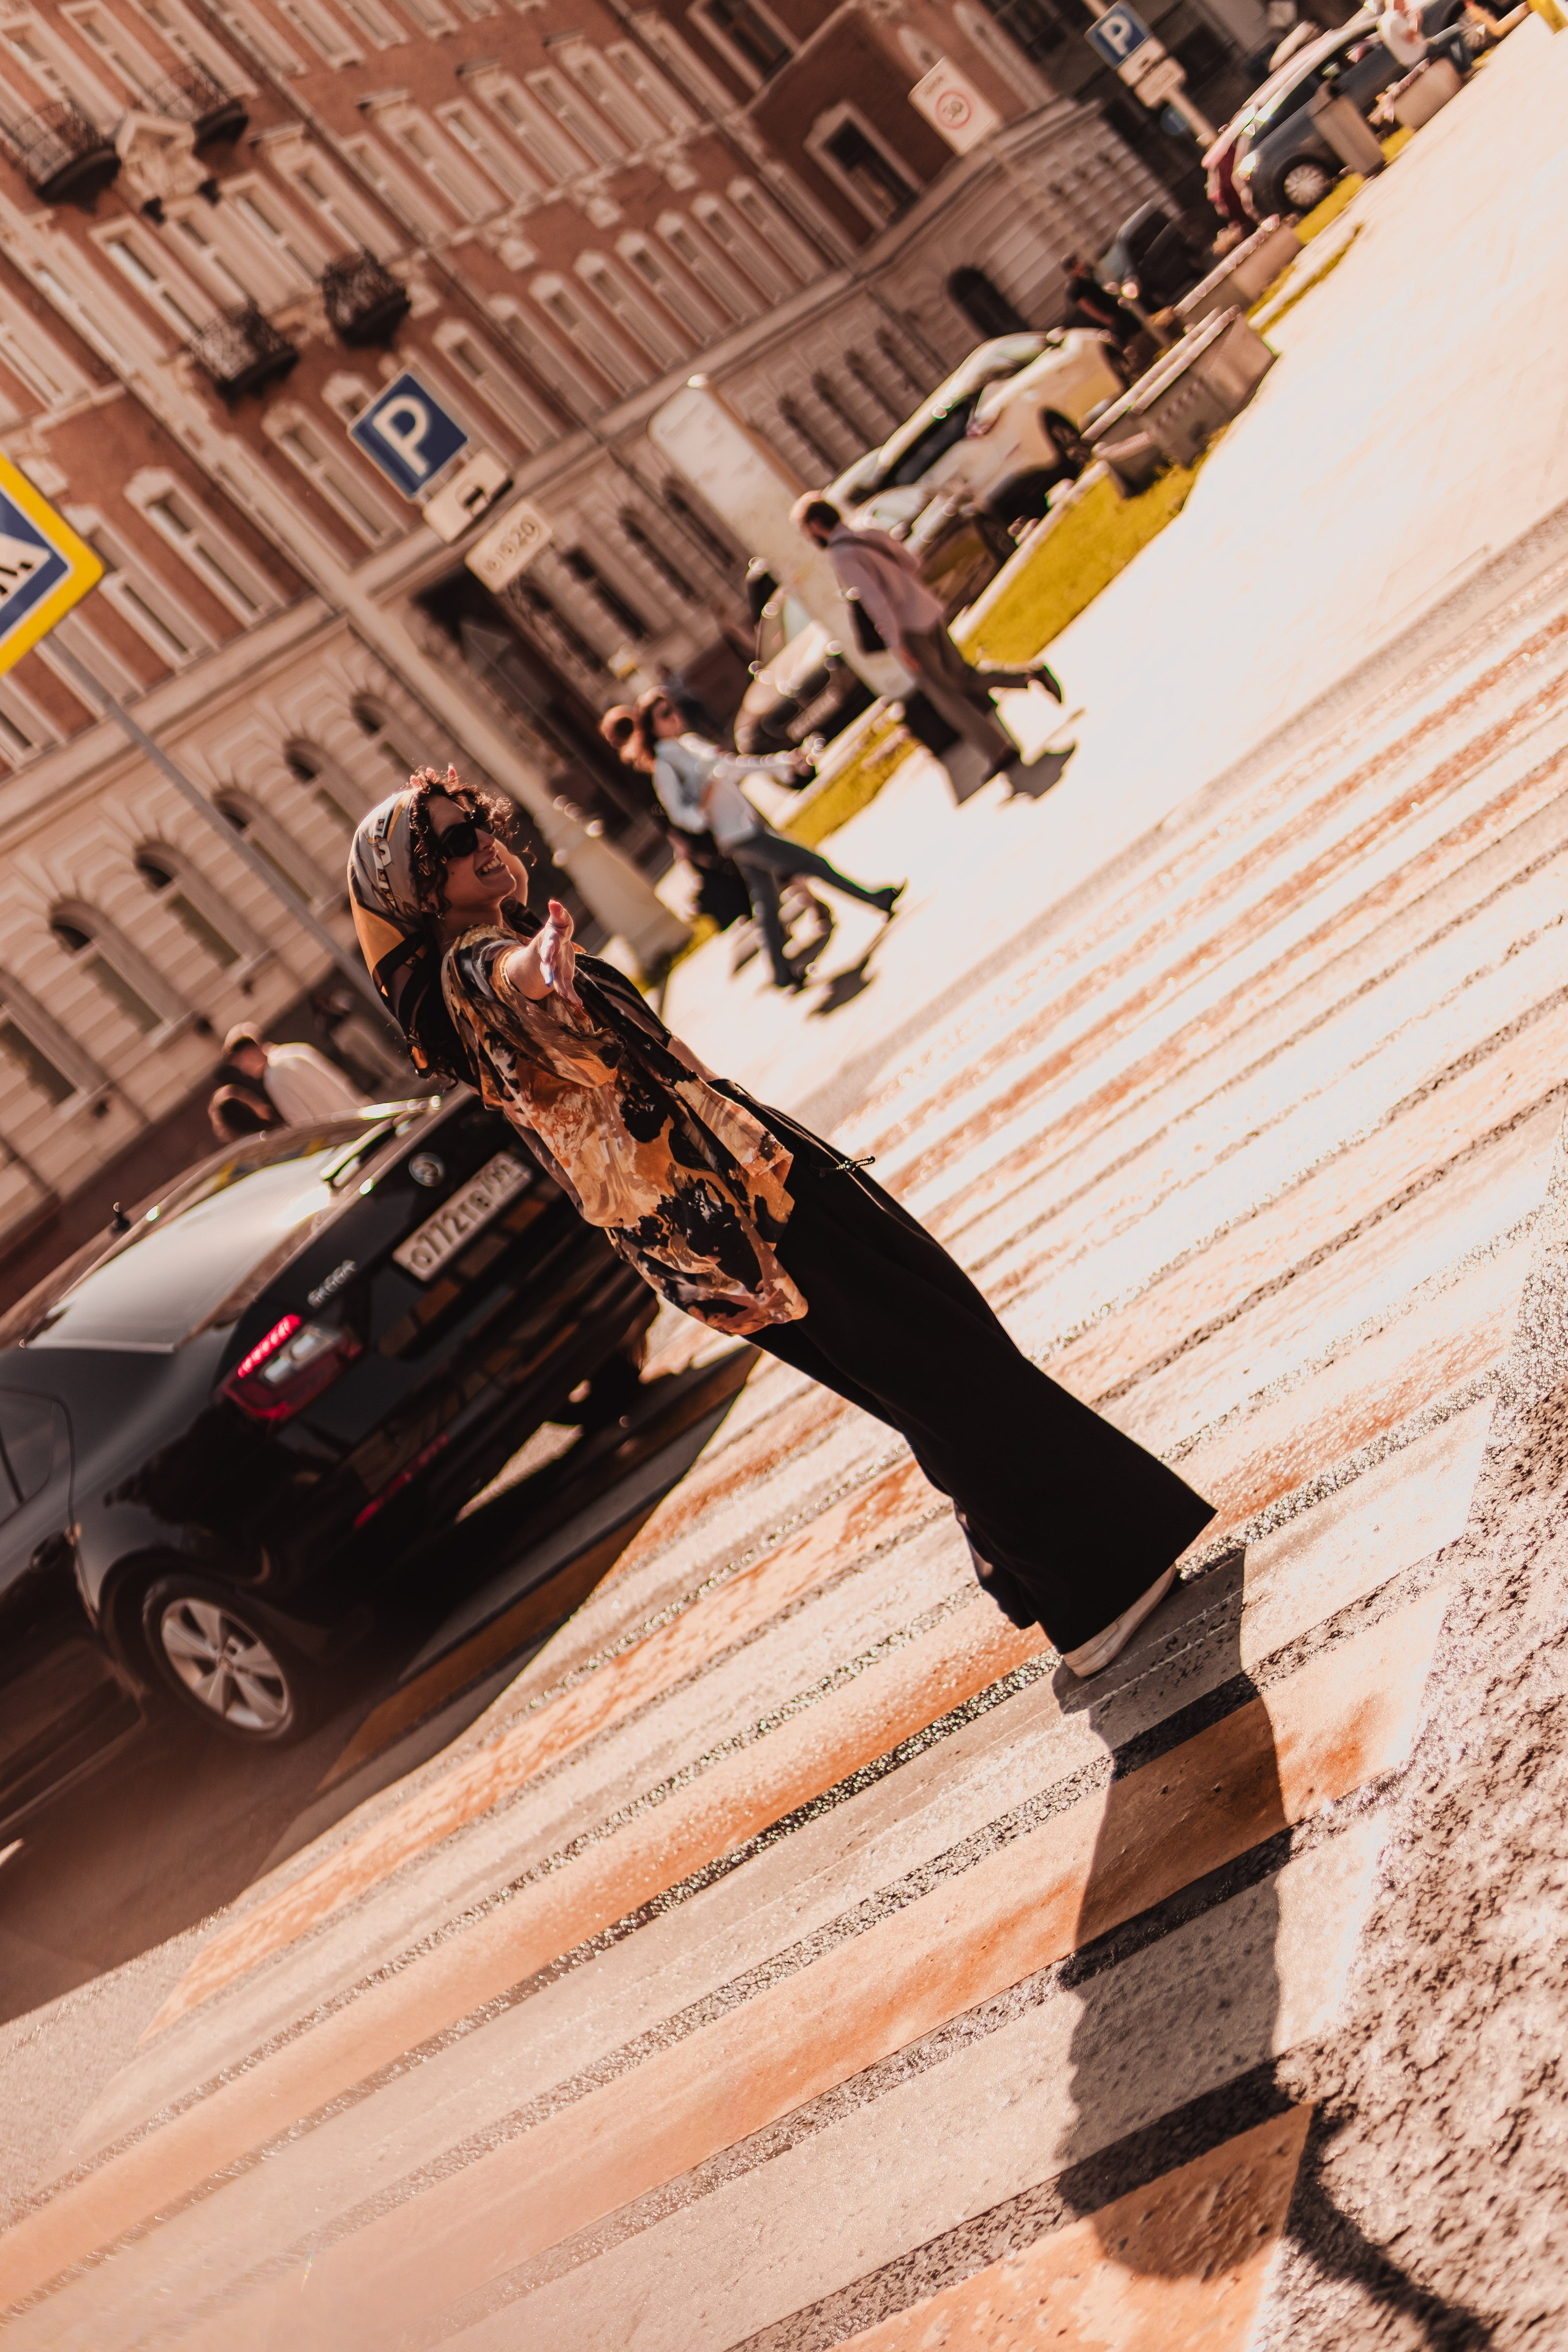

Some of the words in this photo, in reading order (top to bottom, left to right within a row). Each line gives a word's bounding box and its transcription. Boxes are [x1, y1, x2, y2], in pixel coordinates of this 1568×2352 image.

[1098, 16, 1131, 55] P
[372, 394, 428, 477] P
[510, 516, 540, 547] 20
